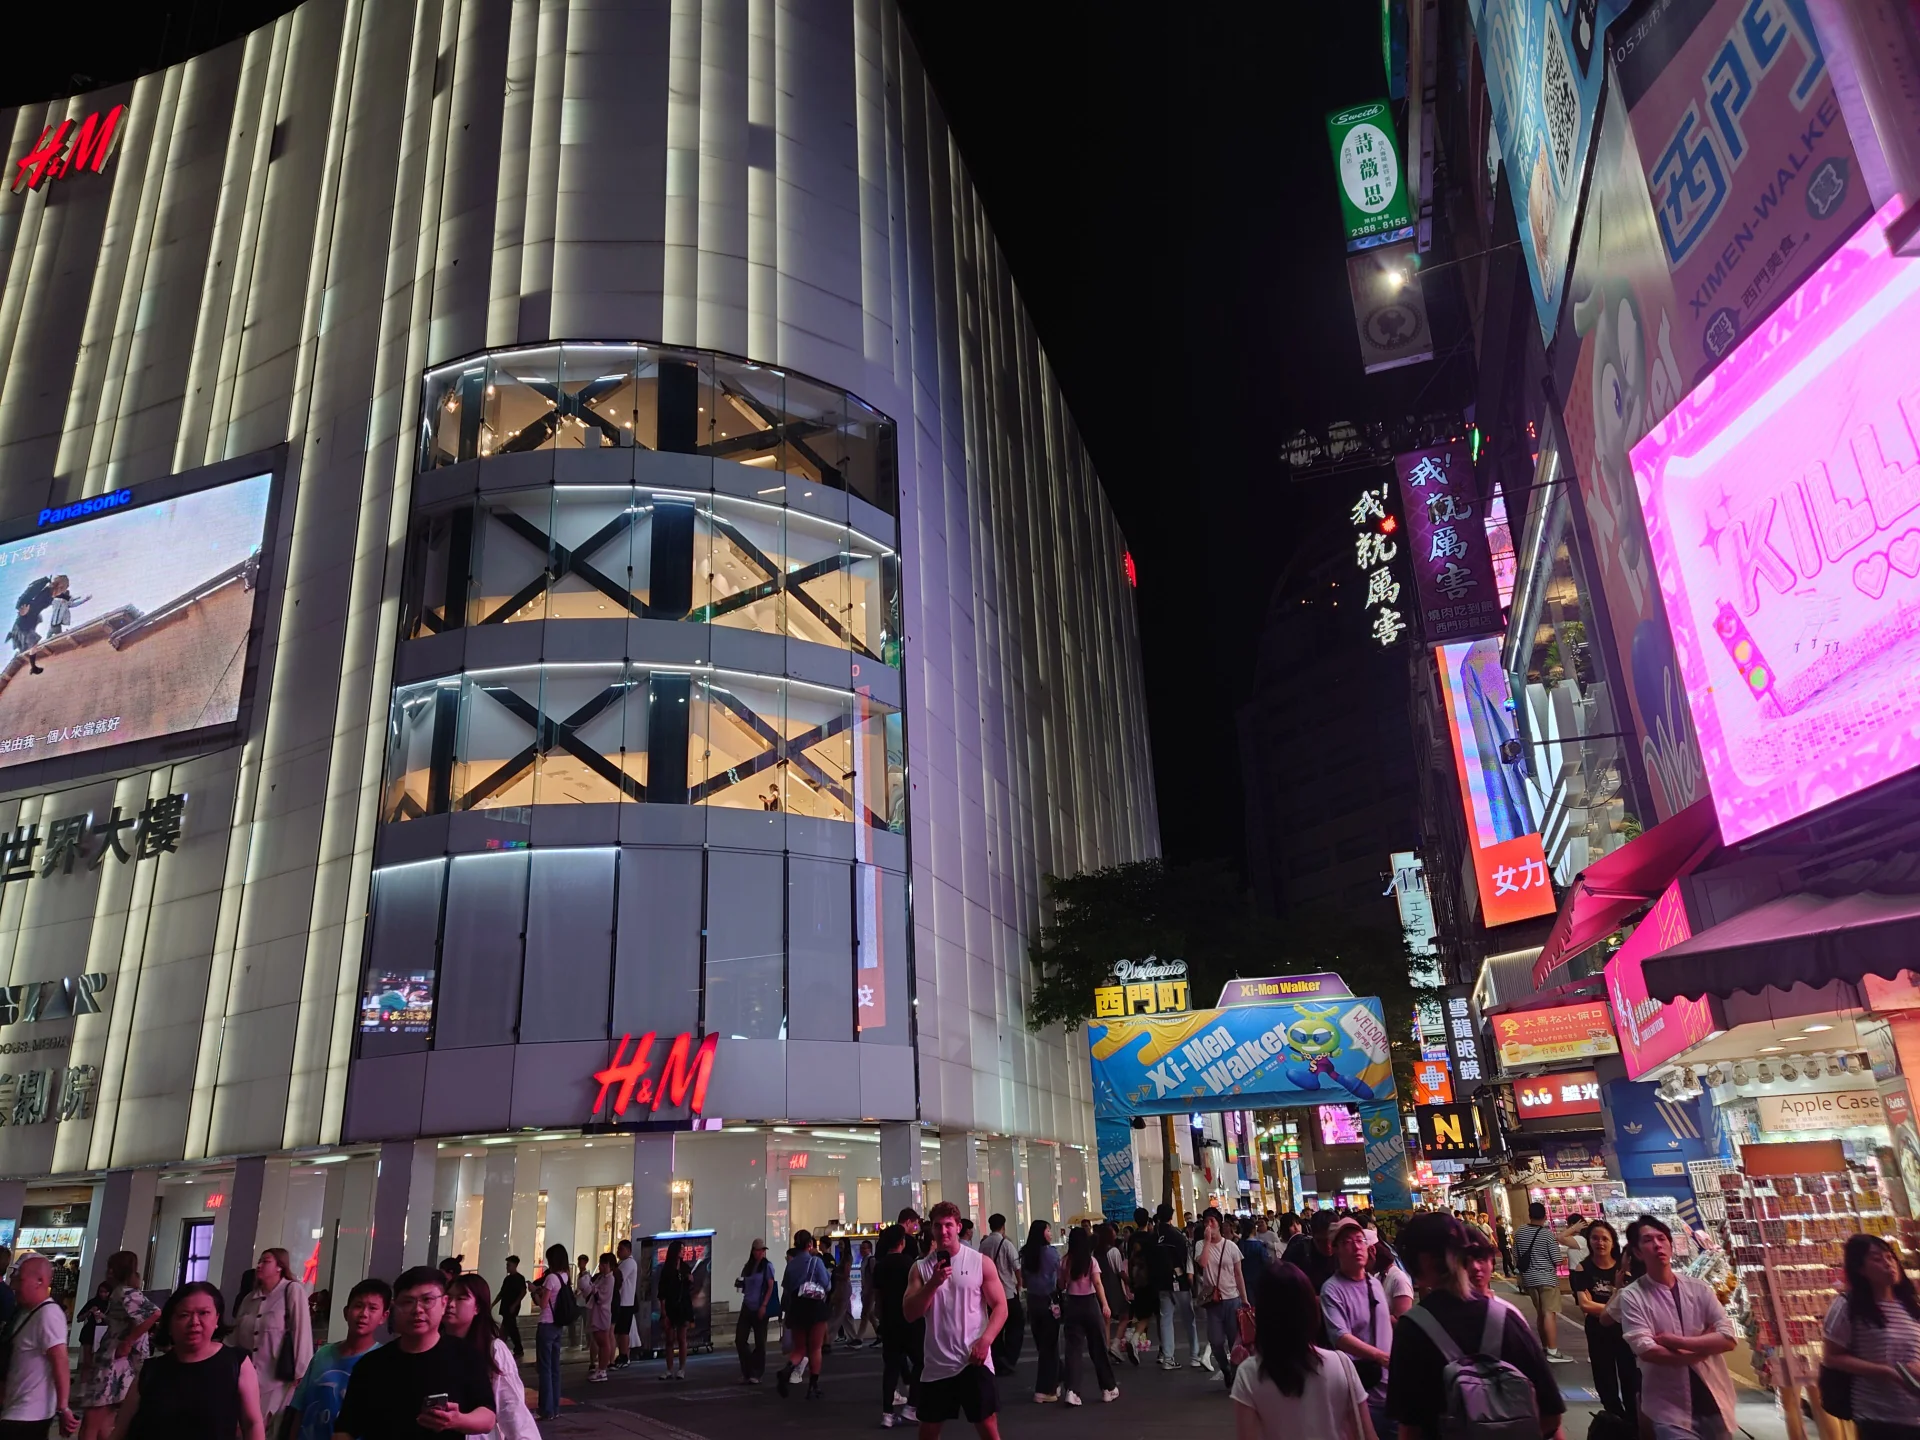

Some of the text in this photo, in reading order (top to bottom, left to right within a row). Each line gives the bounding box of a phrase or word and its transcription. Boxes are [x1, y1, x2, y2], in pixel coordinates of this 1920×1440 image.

[1337, 105, 1379, 124] Sweith
[10, 105, 126, 192] H&M
[1354, 131, 1385, 207] 詩薇思
[1351, 216, 1408, 237] 2388-8155
[37, 488, 131, 527] Panasonic
[1722, 394, 1920, 618] KILL
[1427, 601, 1495, 622] 燒肉吃到飽
[1114, 956, 1189, 981] Welcome
[1094, 981, 1188, 1018] 西門町
[1240, 980, 1321, 997] Xi-Men Walker
[1523, 1009, 1603, 1028] 大黑松小倆口
[1448, 997, 1482, 1081] 雪龍眼鏡
[593, 1031, 720, 1116] H&M
[1144, 1024, 1236, 1100] Xi-Men
[1200, 1021, 1291, 1096] Walker
[1780, 1095, 1832, 1117] Apple
[1836, 1094, 1881, 1111] Case
[1362, 1134, 1405, 1172] alke
